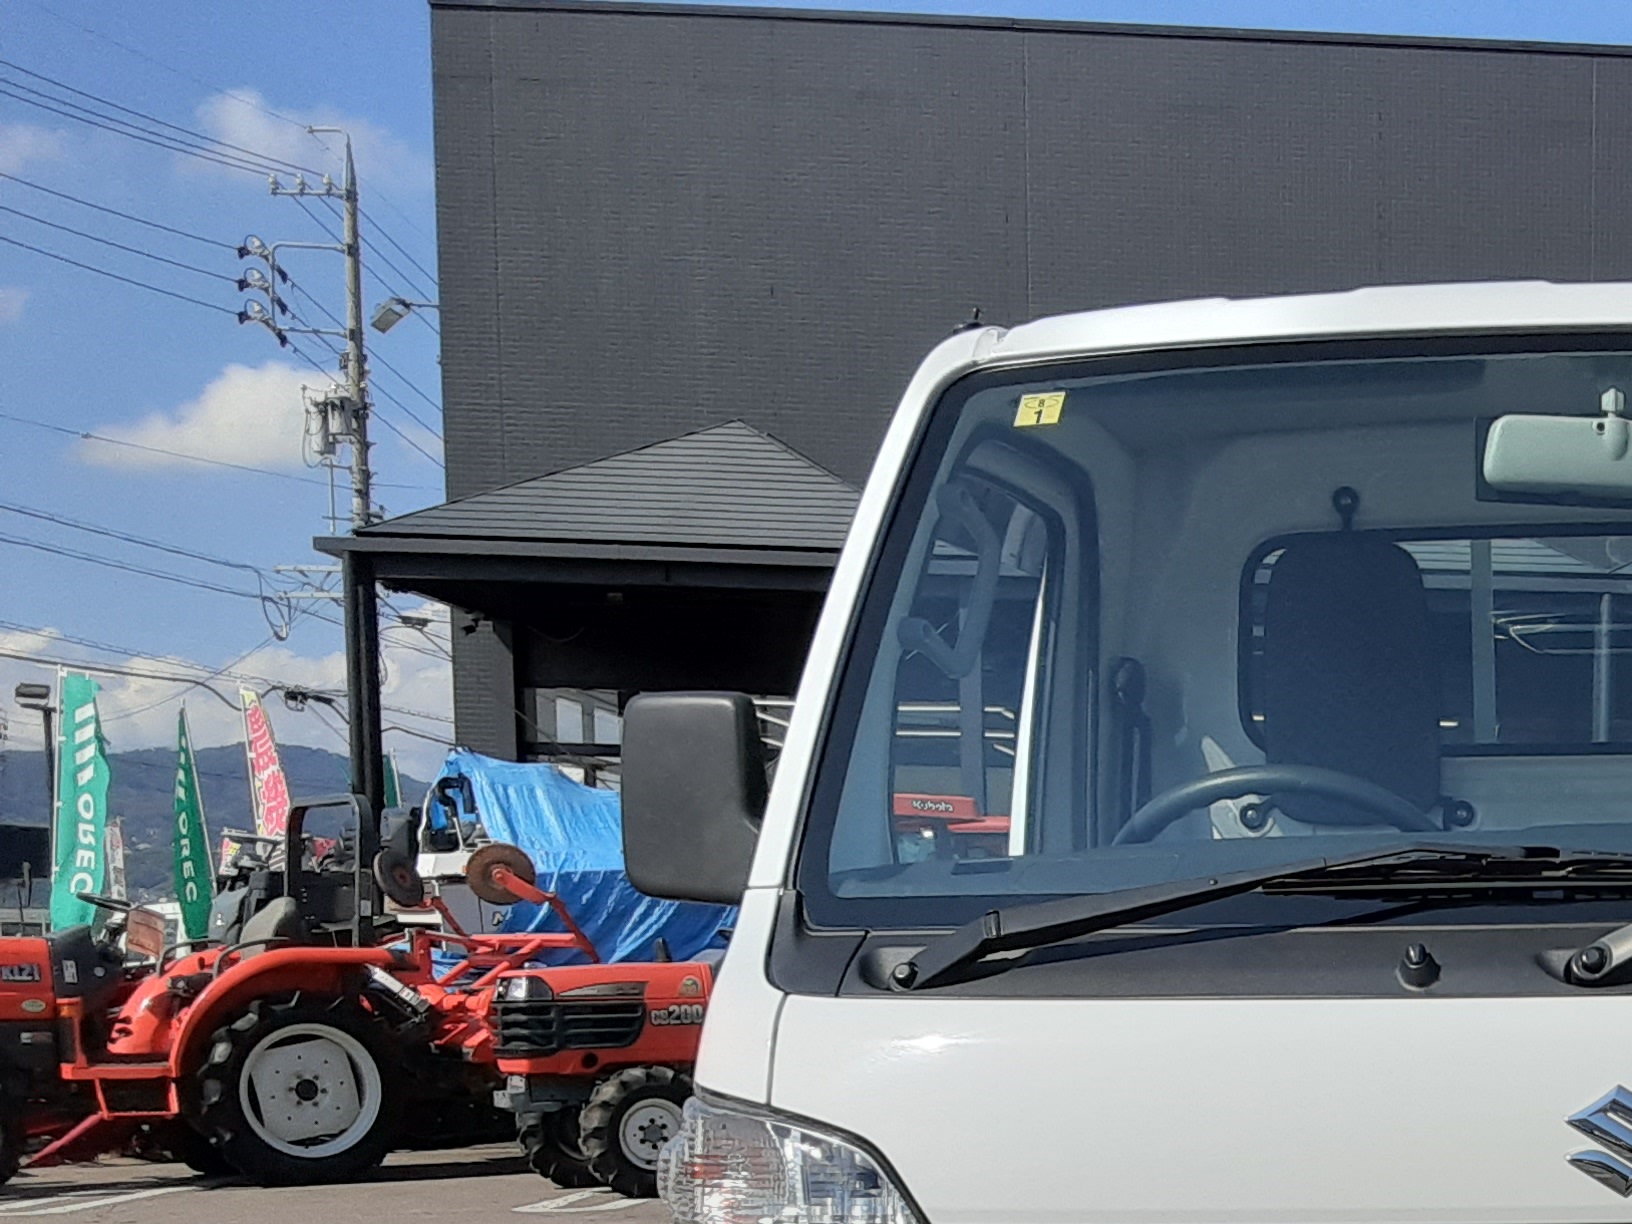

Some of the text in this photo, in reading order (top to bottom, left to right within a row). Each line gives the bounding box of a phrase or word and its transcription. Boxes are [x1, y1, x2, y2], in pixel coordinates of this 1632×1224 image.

[1034, 409, 1043, 424] 1
[912, 800, 954, 812] Kubota
[178, 812, 198, 903] OREC
